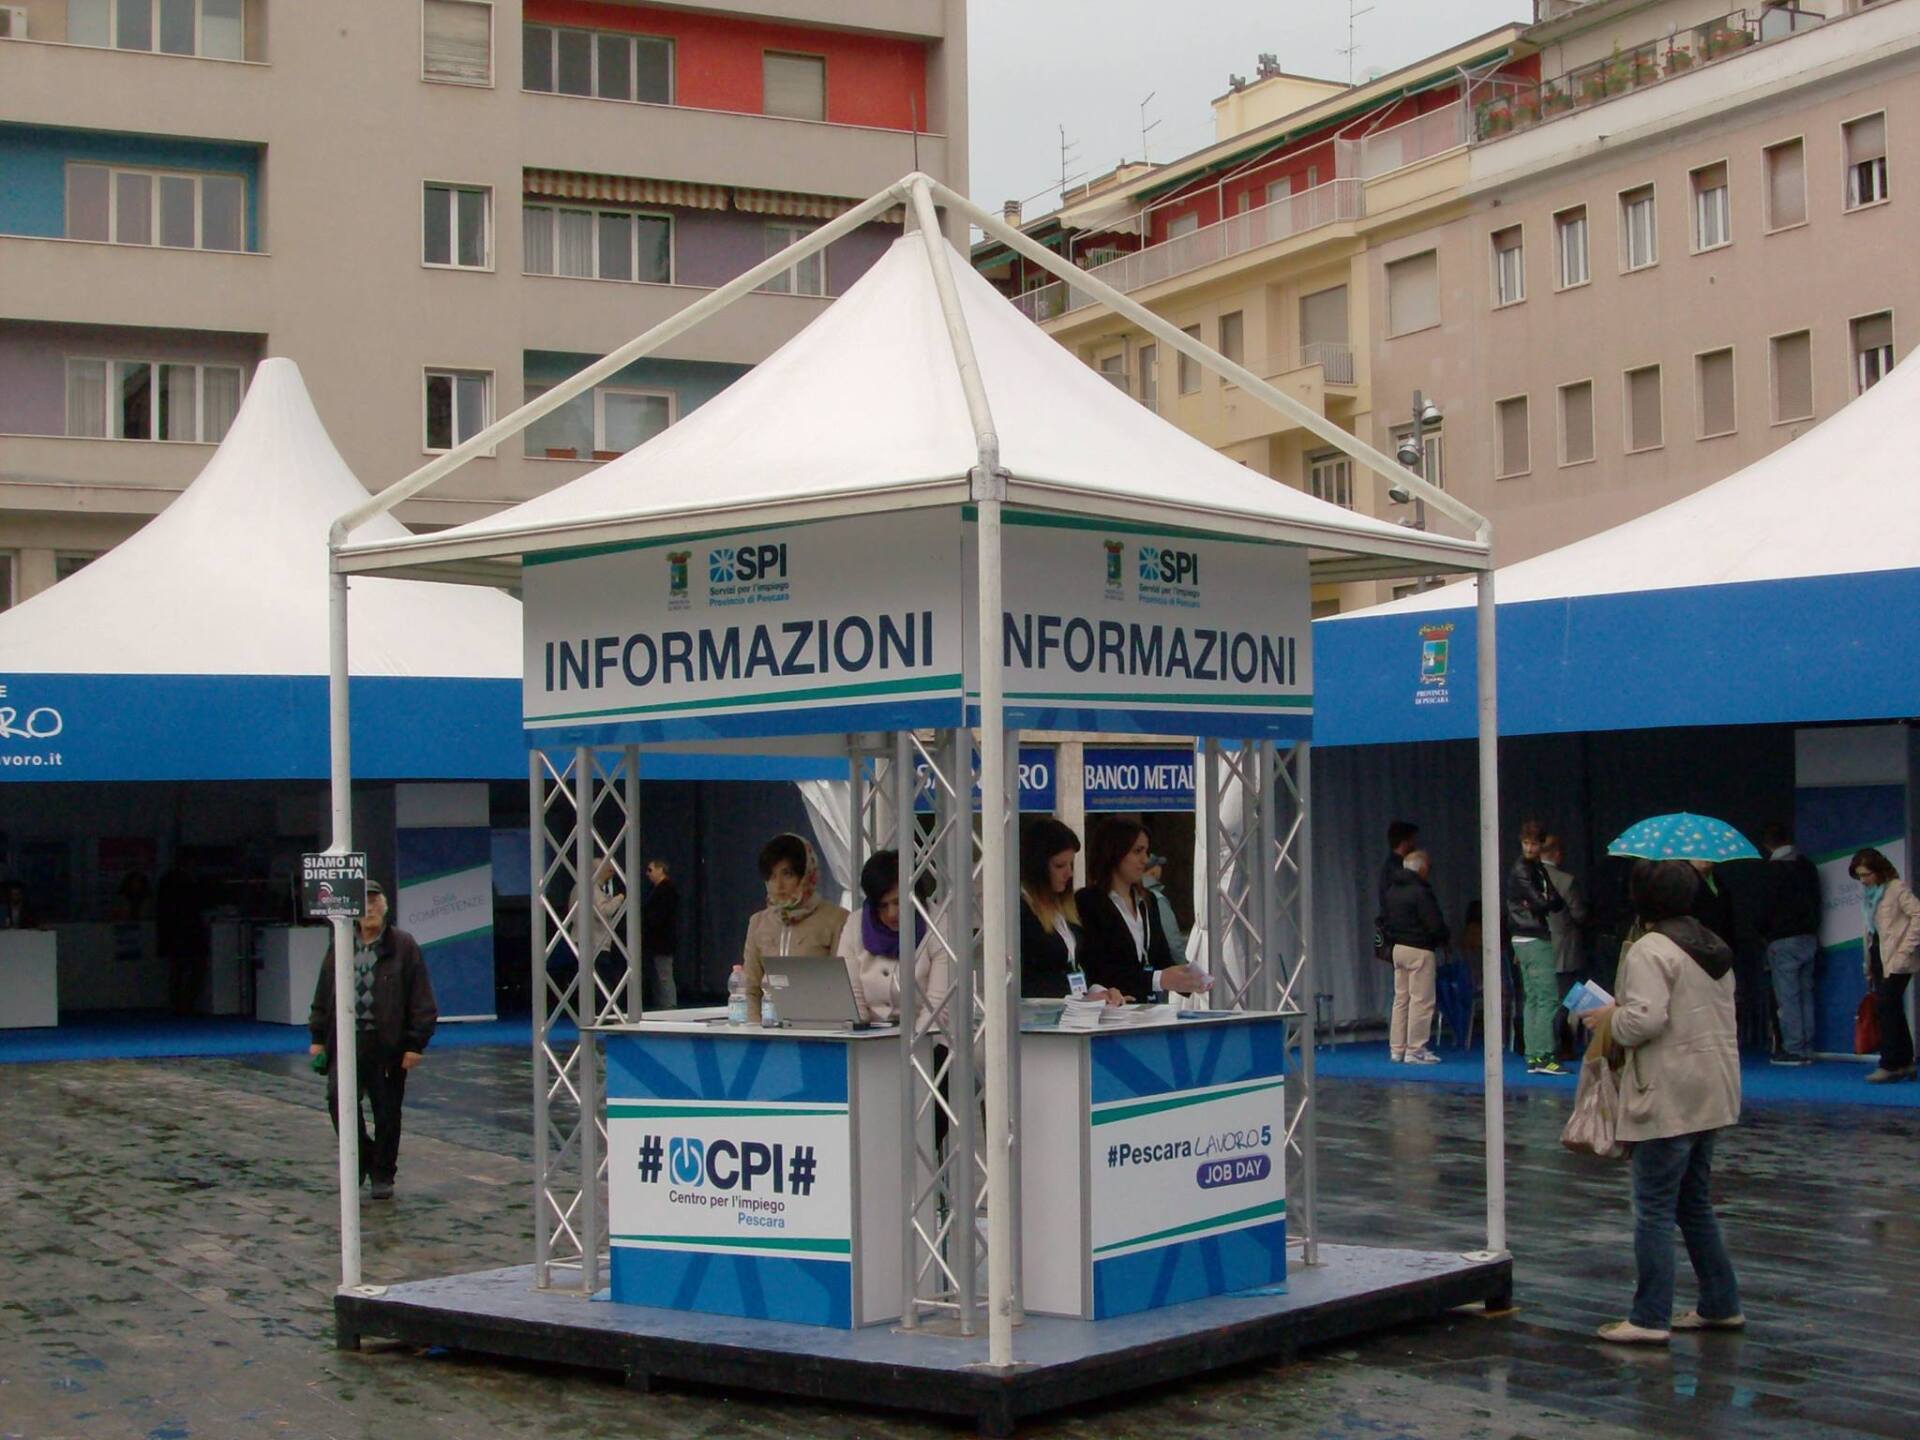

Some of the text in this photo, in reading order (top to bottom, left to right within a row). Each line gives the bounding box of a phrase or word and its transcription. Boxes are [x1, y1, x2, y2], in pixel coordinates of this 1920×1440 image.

[736, 543, 787, 581] SPI
[1160, 549, 1198, 585] SPI
[737, 585, 751, 595] per
[544, 611, 934, 692] INFORMAZIONI
[1002, 612, 1296, 686] NFORMAZIONI
[0, 753, 63, 766] voro.it
[1084, 764, 1140, 790] BANCO
[303, 856, 364, 868] SIAMO IN
[303, 868, 364, 880] DIRETTA
[1204, 1158, 1263, 1185] JOB DAY
[669, 1189, 786, 1214] Centro per l'impiego
[737, 1212, 786, 1229] Pescara
